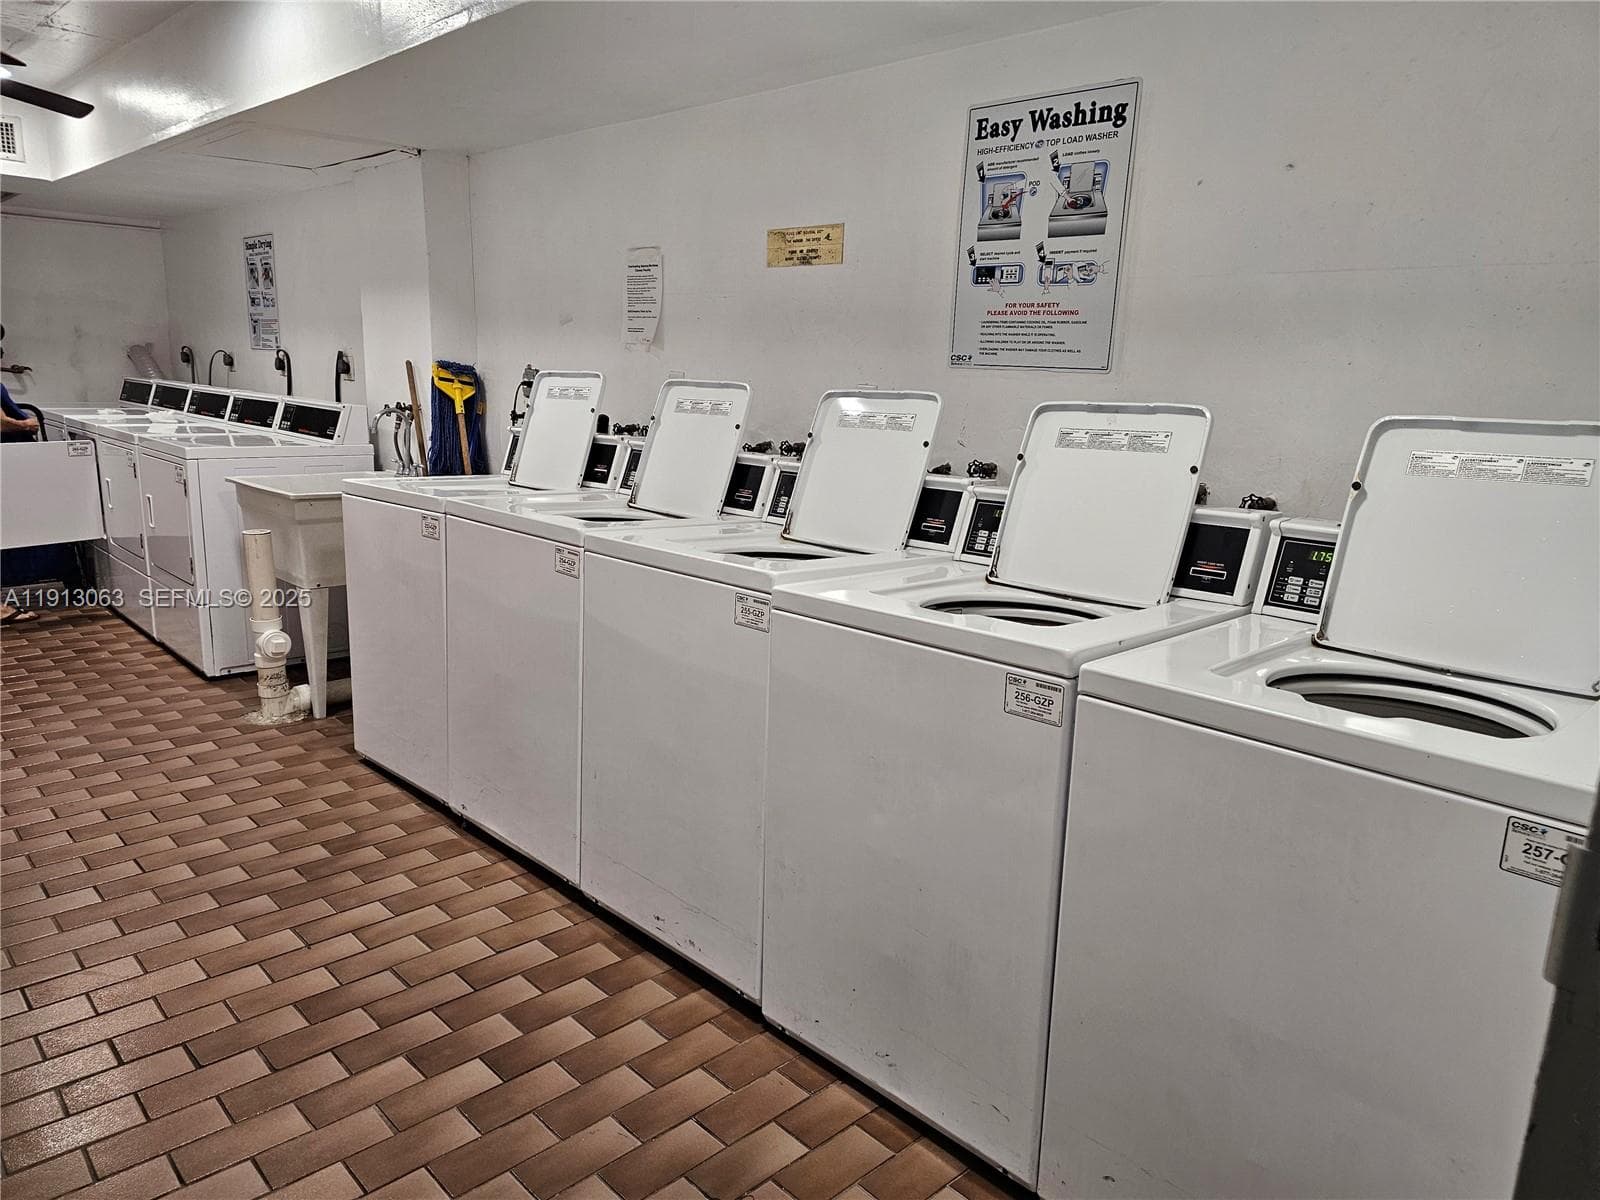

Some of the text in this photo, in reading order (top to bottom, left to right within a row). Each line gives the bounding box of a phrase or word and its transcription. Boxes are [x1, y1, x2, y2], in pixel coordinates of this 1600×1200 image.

[974, 100, 1129, 142] Easy Washing
[976, 130, 1119, 156] HIGH-EFFICIENCY TOP LOAD WASHER
[245, 240, 272, 252] Simple Drying
[740, 606, 765, 618] 255-GZP
[1014, 690, 1054, 708] 256-GZP
[1511, 821, 1540, 833] CSC
